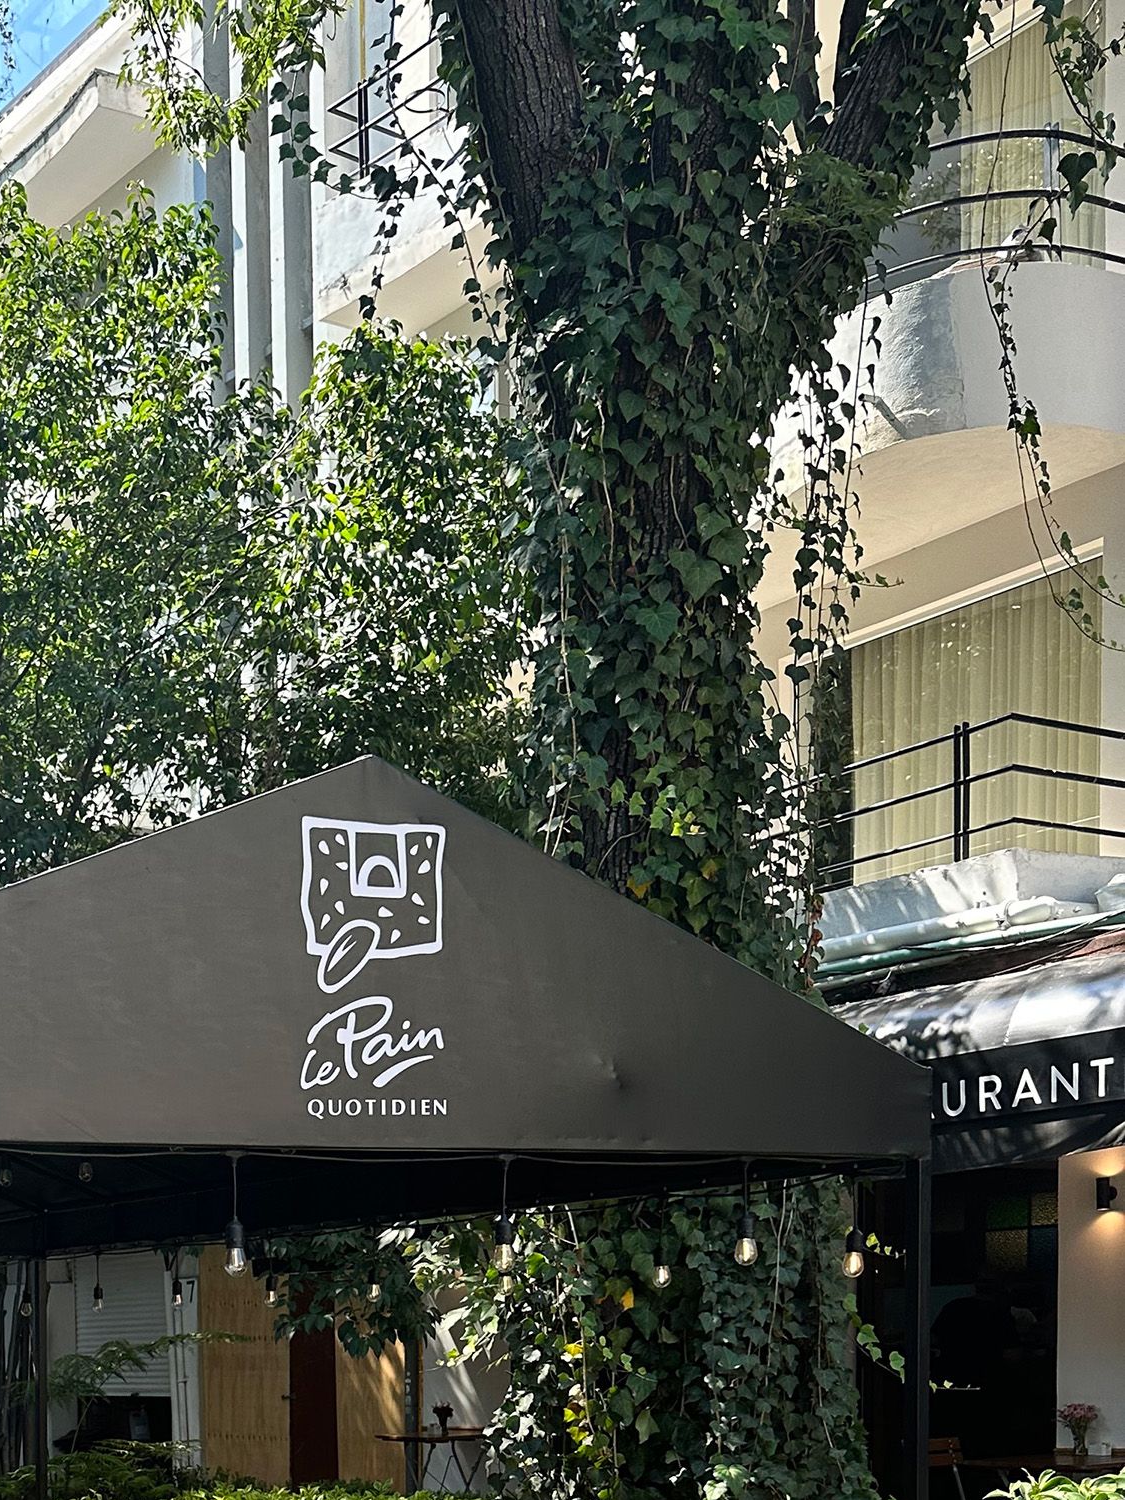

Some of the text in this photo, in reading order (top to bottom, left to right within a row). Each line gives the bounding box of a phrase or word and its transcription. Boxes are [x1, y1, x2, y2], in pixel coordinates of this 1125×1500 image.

[306, 995, 445, 1079] Pain
[307, 1098, 448, 1120] QUOTIDIEN
[931, 1057, 1115, 1119] URANT
